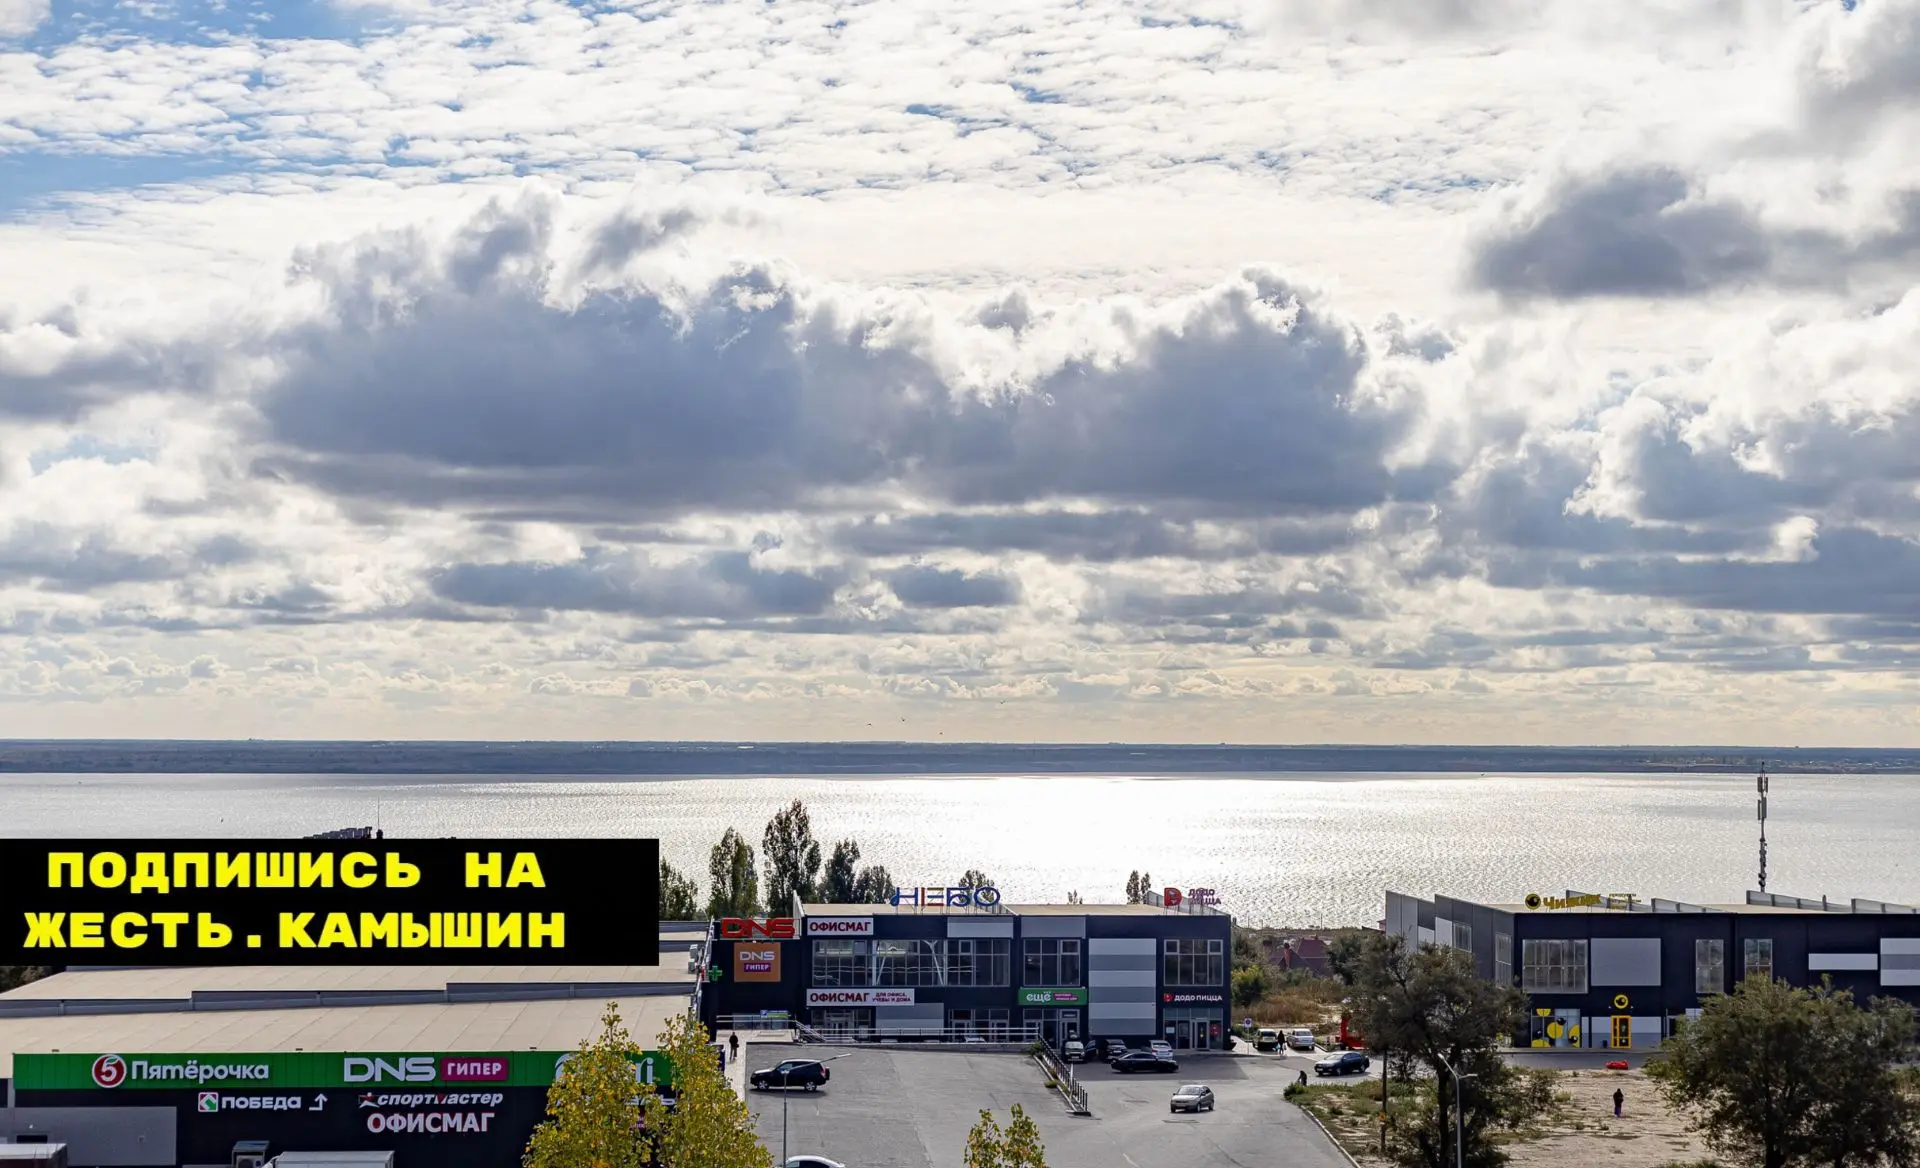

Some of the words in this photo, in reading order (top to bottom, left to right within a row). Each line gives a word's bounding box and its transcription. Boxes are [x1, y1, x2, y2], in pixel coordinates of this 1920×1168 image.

[889, 886, 1001, 907] НЕБО
[721, 917, 796, 939] DNS
[809, 921, 871, 932] ОФИСМАГ
[740, 951, 776, 961] DNS
[744, 963, 770, 971] ГИПЕР
[810, 992, 870, 1003] ОФИСМАГ
[131, 1059, 269, 1084] Пятёрочка
[343, 1057, 437, 1082] DNS
[447, 1062, 503, 1076] ГИПЕР
[366, 1112, 495, 1134] ОФИСМАГ
